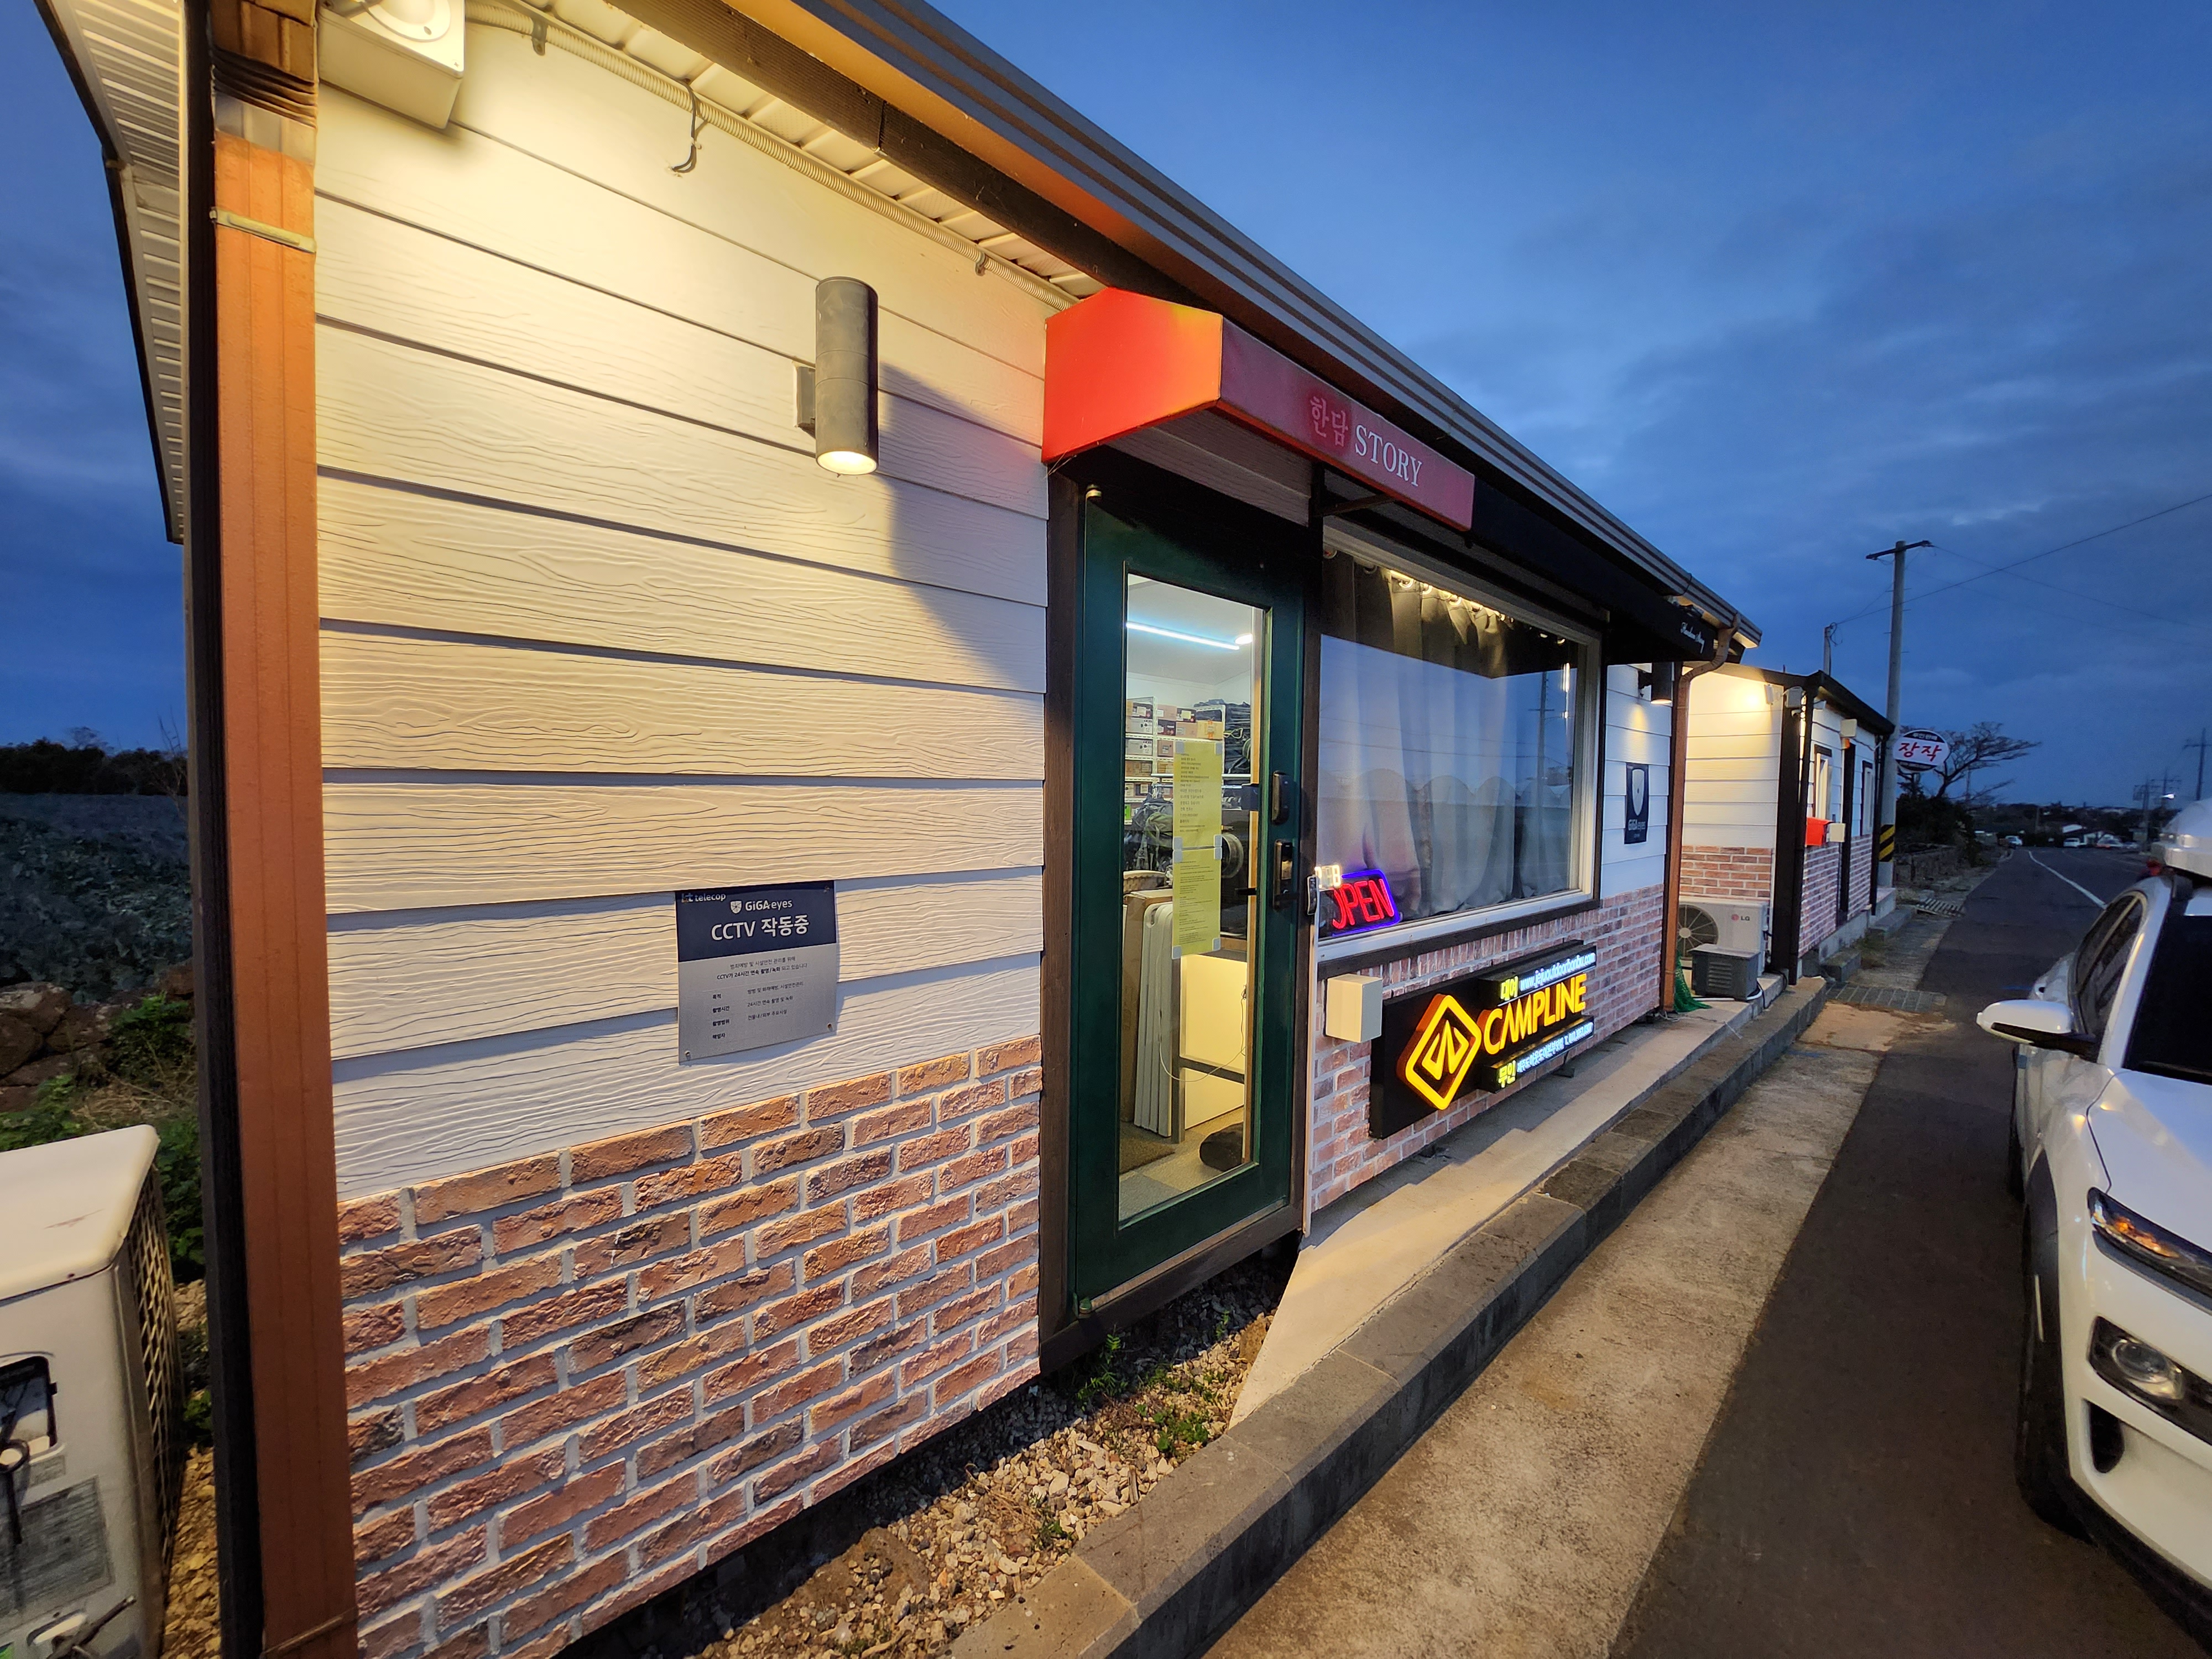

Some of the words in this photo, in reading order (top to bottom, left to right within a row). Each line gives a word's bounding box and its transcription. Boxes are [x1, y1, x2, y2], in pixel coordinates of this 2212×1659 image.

[1310, 395, 1349, 447] 한담
[1354, 424, 1424, 487] STORY
[1898, 742, 1942, 762] 장작
[695, 894, 726, 902] telecop
[711, 921, 756, 941] CCTV
[761, 915, 810, 937] 작동중
[1482, 973, 1588, 1055] CAMPLINE
[1498, 1060, 1516, 1088] 무인
